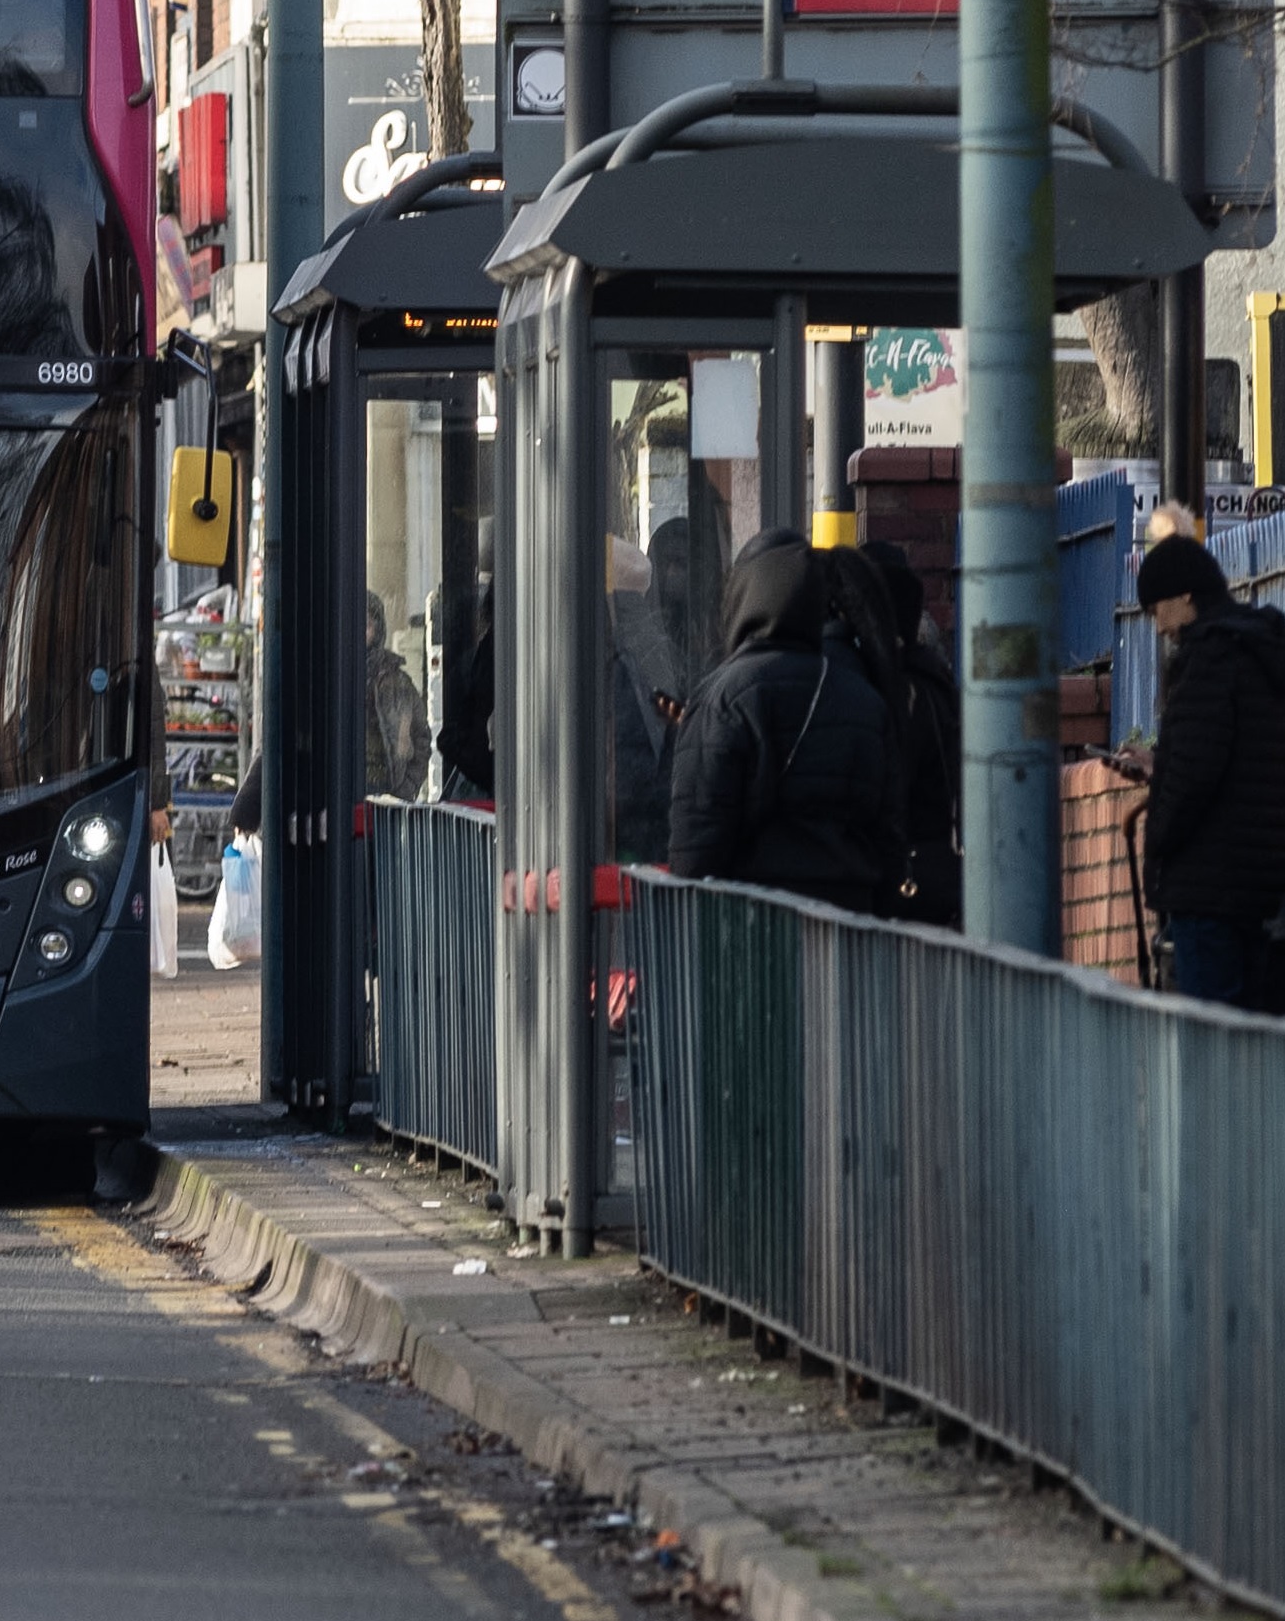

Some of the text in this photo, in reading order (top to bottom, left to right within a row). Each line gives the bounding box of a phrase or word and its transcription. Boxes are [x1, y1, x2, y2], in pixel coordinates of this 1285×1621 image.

[38, 361, 93, 384] 6980
[867, 420, 932, 435] ull-A-Flava
[5, 848, 38, 872] Rose
